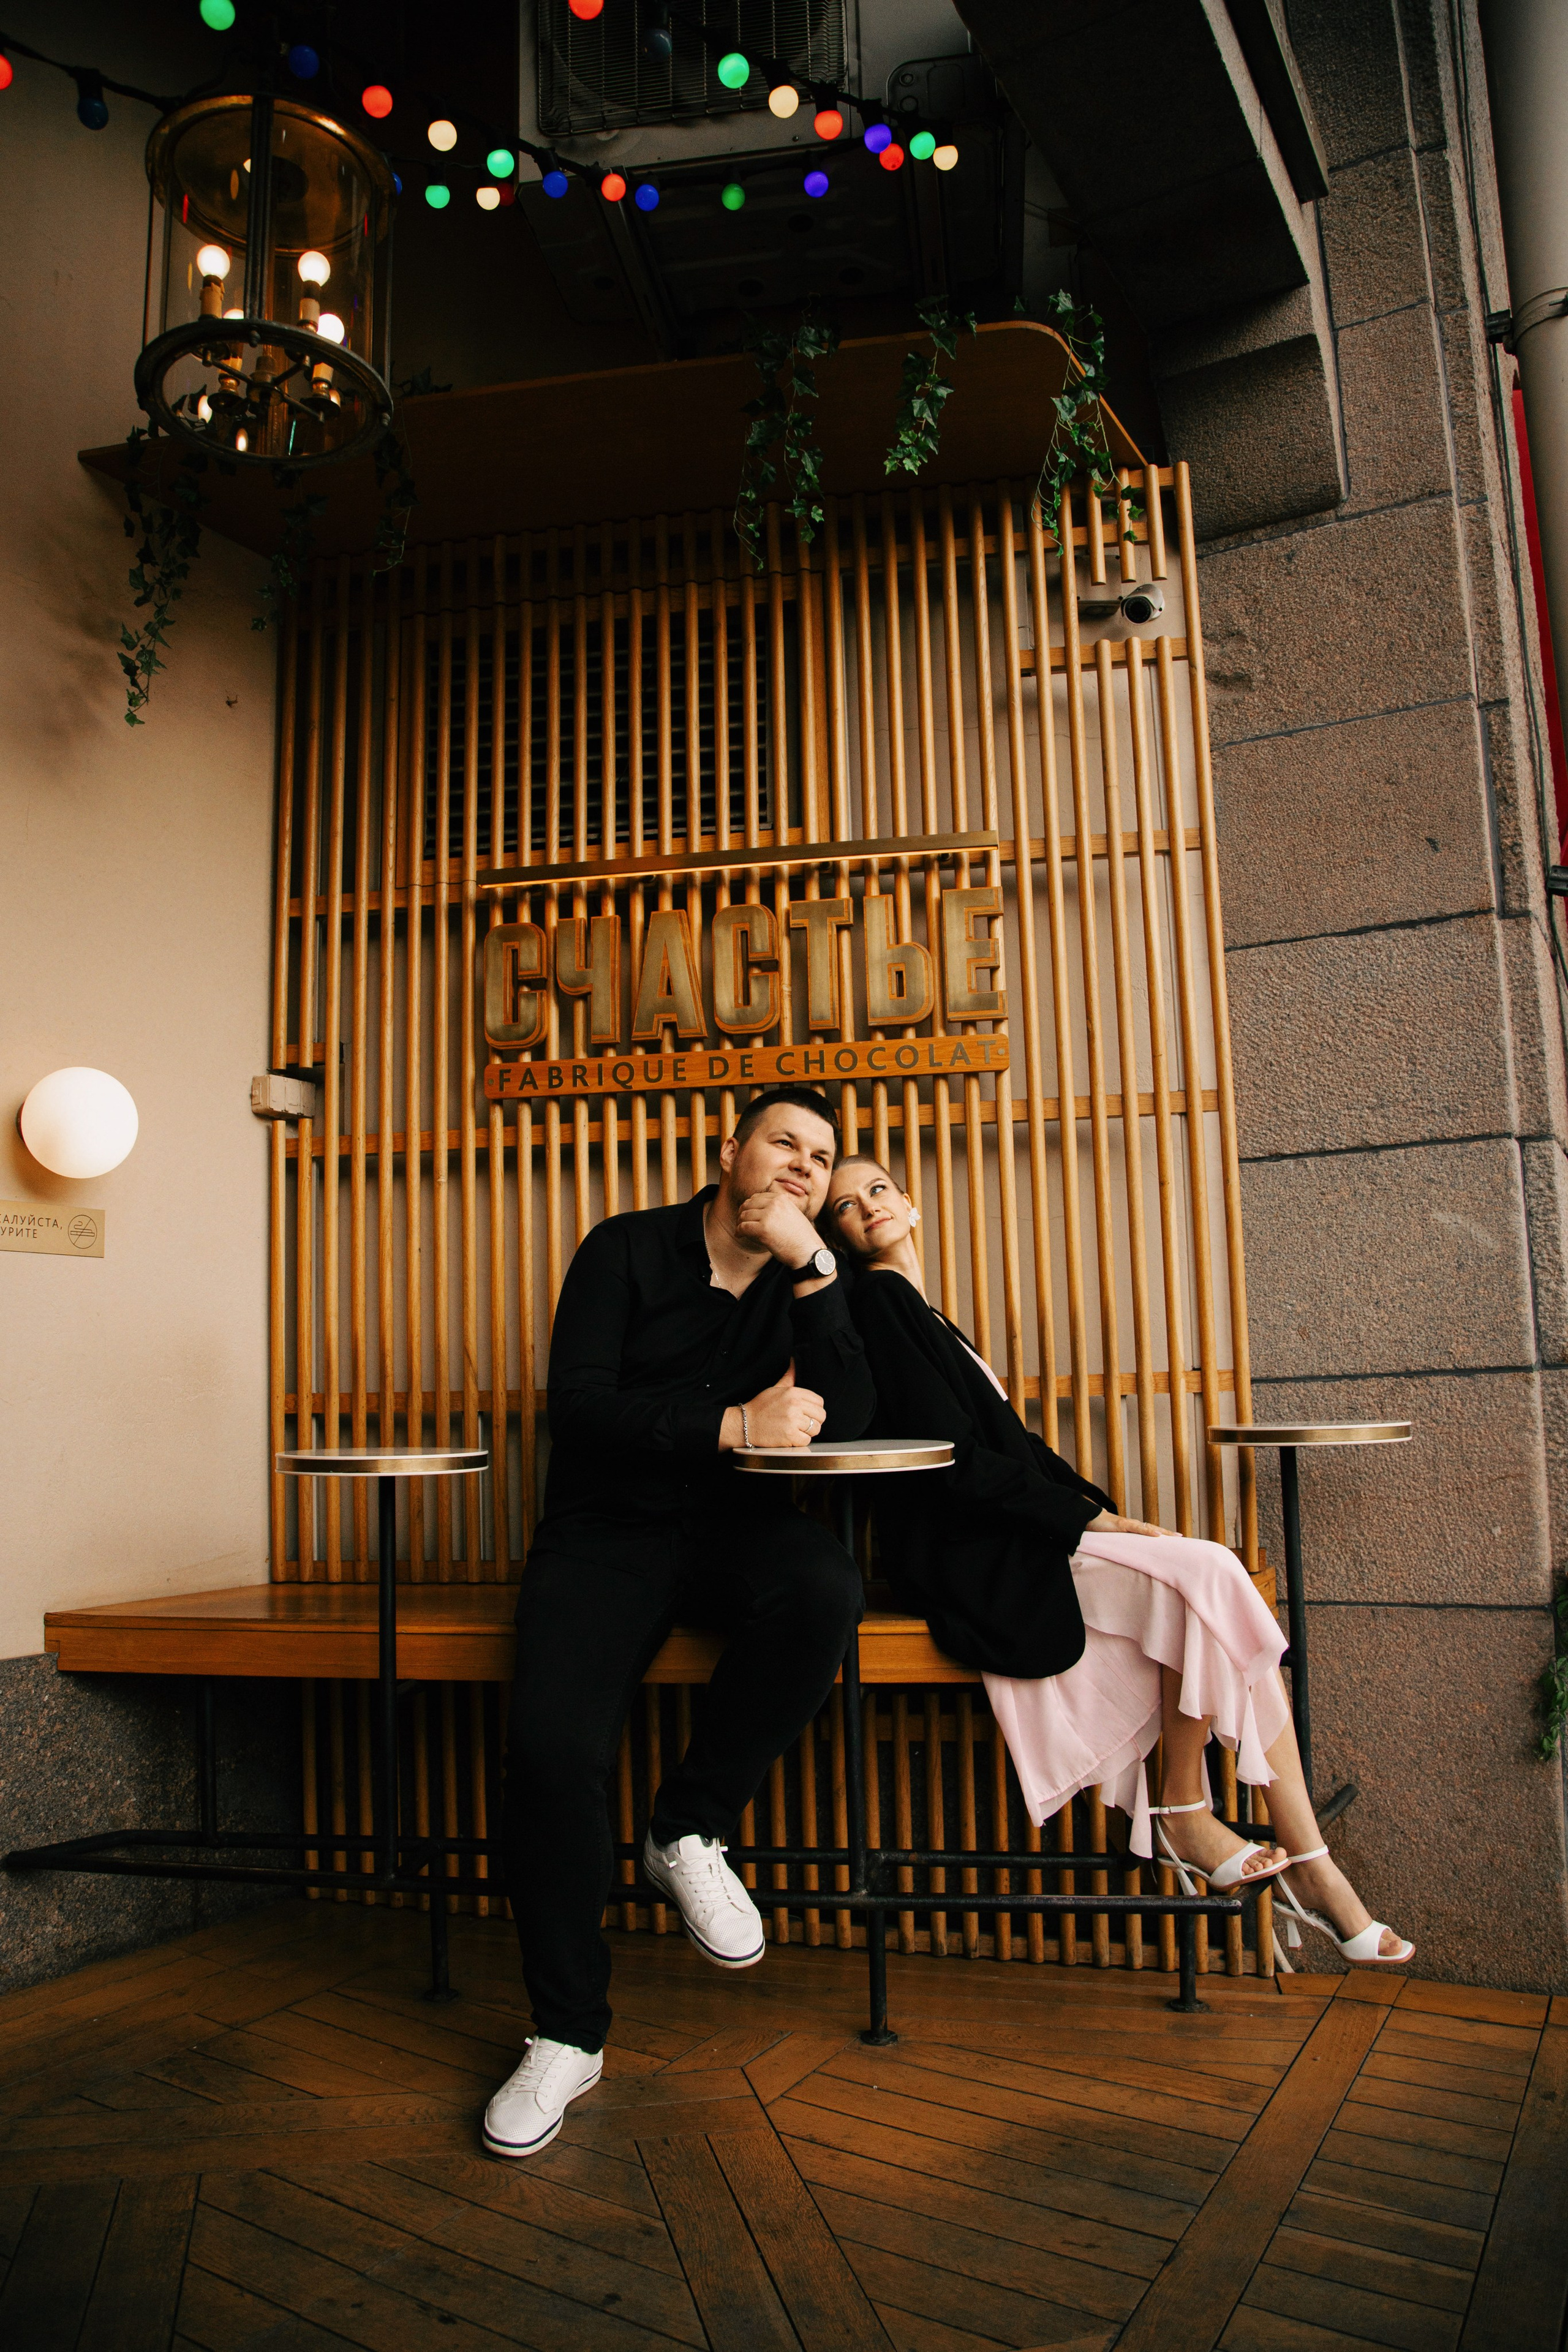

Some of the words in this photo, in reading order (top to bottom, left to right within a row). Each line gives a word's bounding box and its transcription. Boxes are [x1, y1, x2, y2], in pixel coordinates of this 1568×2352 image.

[484, 886, 1009, 1050] СЧАСТЬЕ
[499, 1058, 687, 1092] FABRIQUE
[708, 1054, 755, 1080] DE
[775, 1040, 997, 1076] CHOCOLAT
[0, 1213, 62, 1230] АЛУЙСТА,
